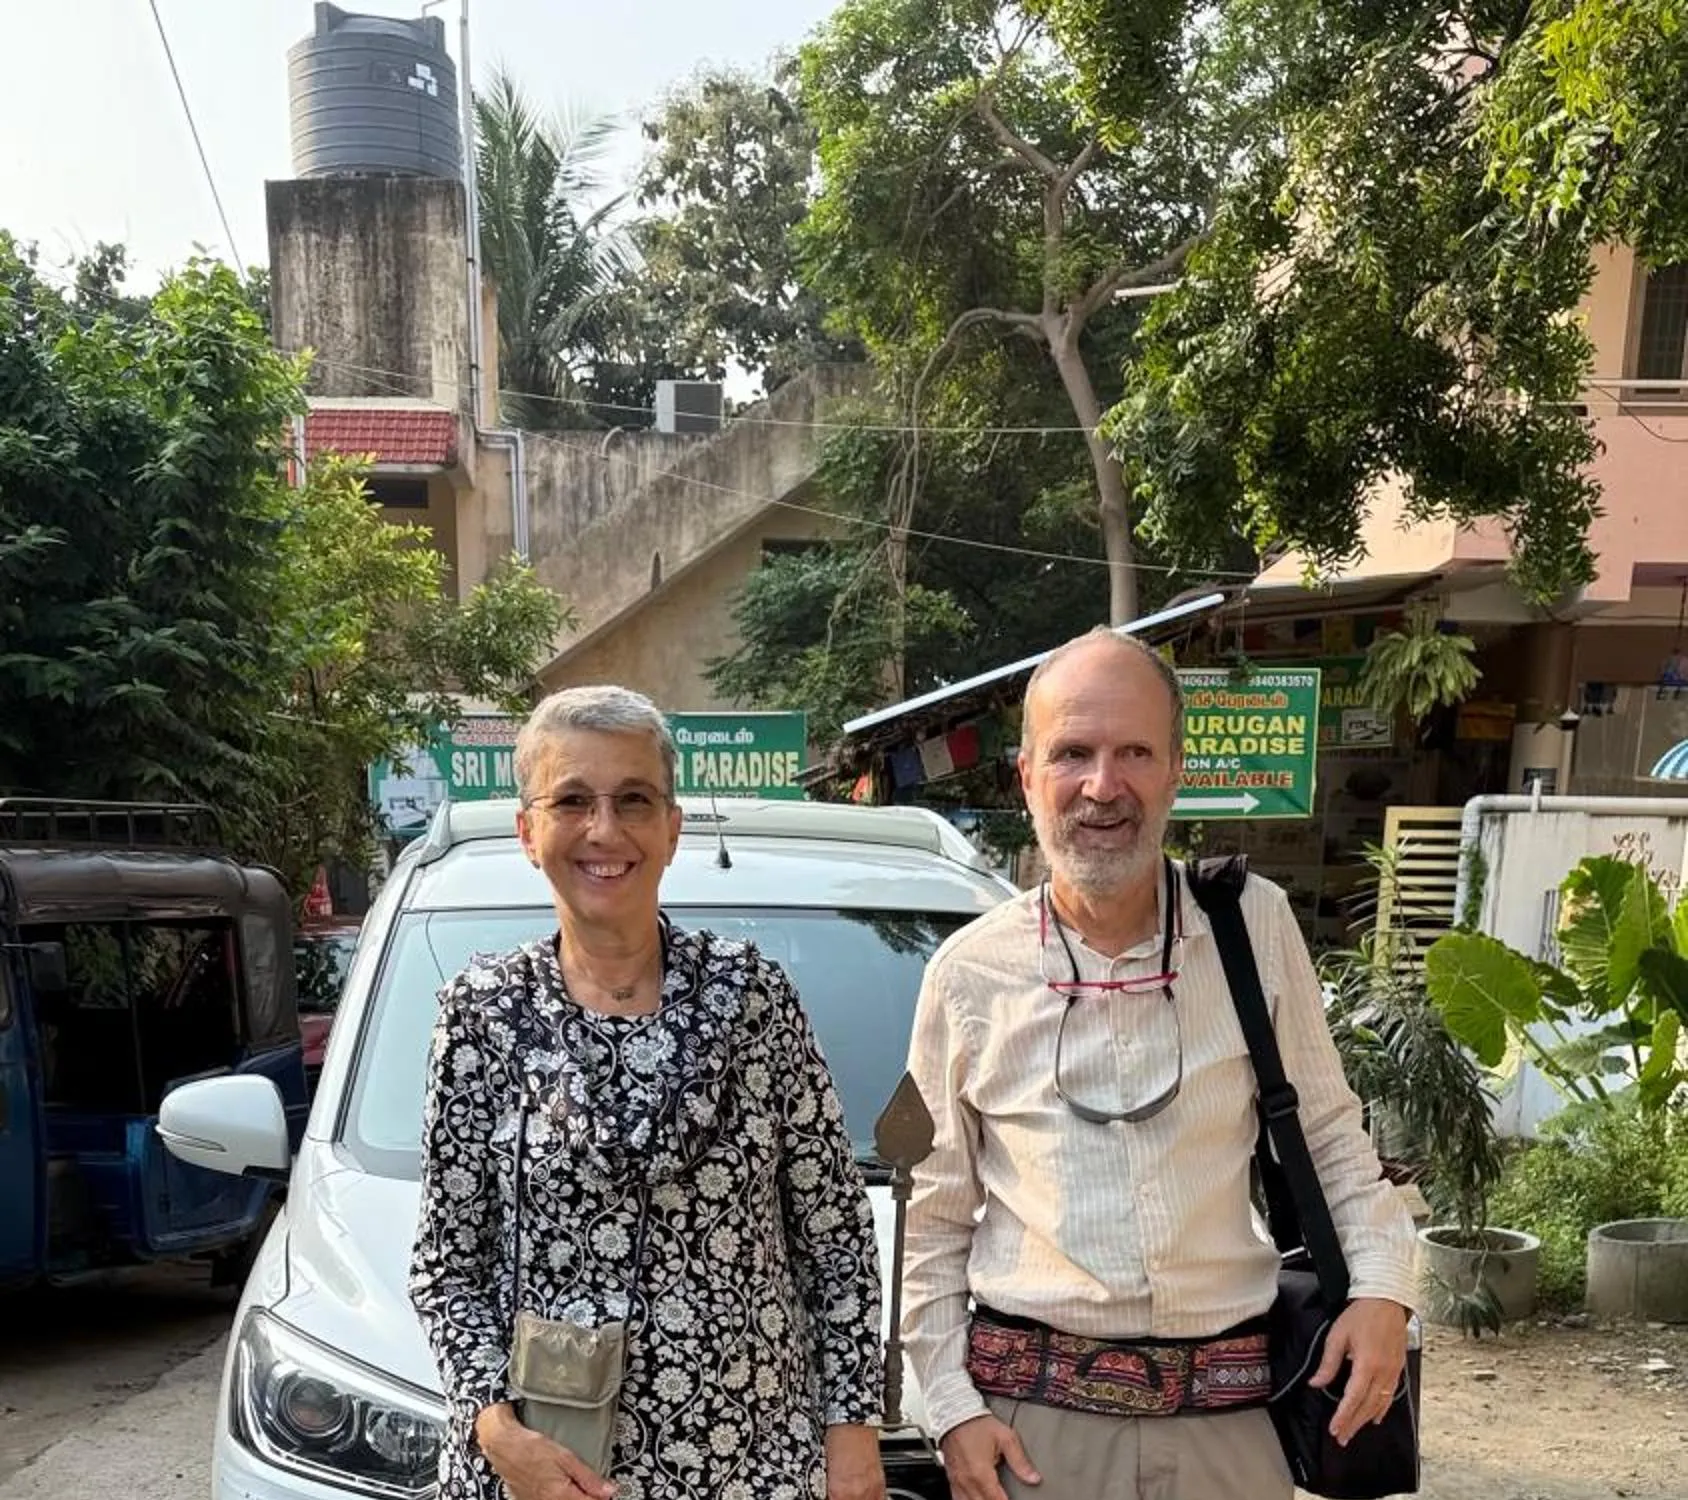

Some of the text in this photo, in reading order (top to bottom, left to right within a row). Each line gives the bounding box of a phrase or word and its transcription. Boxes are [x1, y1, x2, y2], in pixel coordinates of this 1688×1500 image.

[1187, 715, 1306, 735] URUGAN
[1183, 737, 1305, 755] ARADISE
[451, 751, 487, 788] SRI
[691, 751, 800, 788] PARADISE
[1180, 770, 1294, 788] VAILABLE
